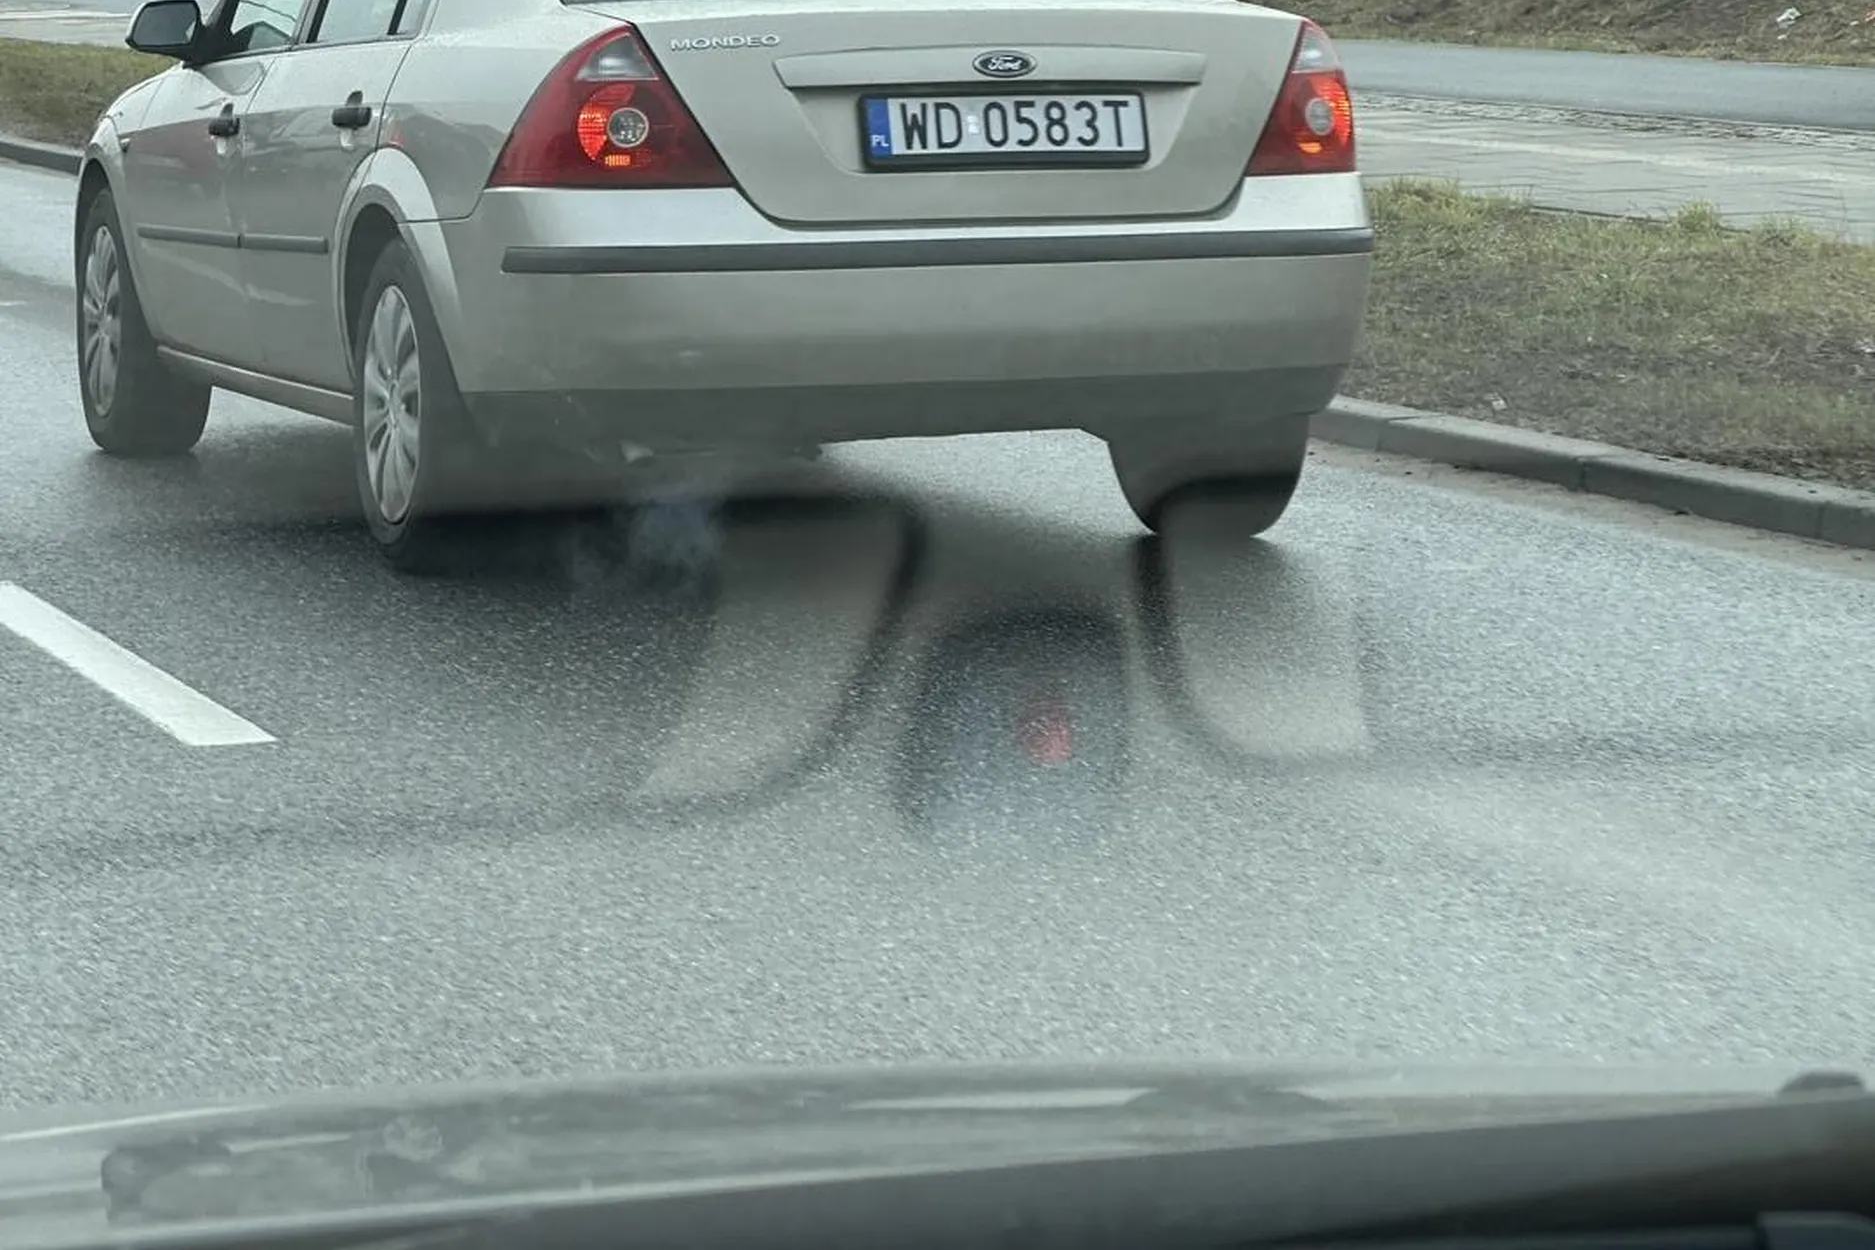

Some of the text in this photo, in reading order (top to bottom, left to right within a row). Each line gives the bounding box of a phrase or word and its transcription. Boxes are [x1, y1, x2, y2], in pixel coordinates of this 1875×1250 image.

[671, 34, 780, 51] MONDEO
[900, 100, 1130, 150] WD 0583T
[871, 134, 889, 148] PL
